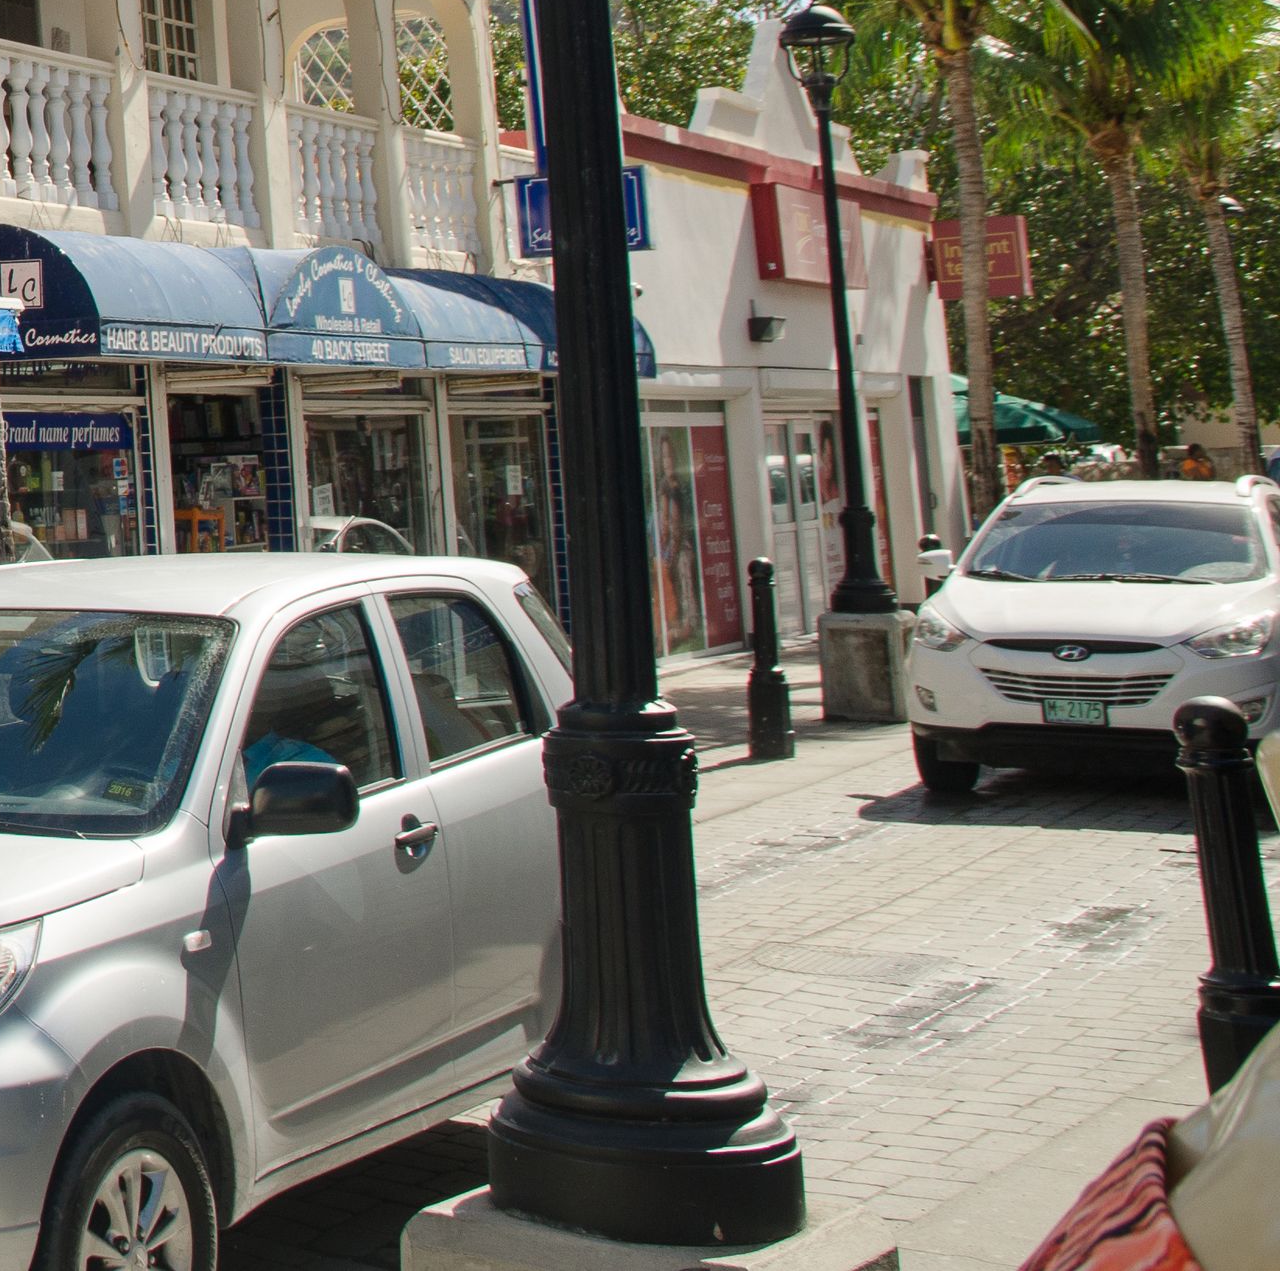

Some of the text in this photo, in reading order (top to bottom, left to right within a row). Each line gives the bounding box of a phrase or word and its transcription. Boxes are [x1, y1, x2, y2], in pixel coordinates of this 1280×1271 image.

[25, 327, 97, 348] Cosmetics
[106, 327, 263, 358] HAIR & BEAUTY PRODUCTS
[311, 338, 391, 363] 40 BACK STREET
[448, 346, 477, 365] SALON
[1, 419, 121, 449] Brand name perfumes
[1066, 700, 1103, 720] 2175
